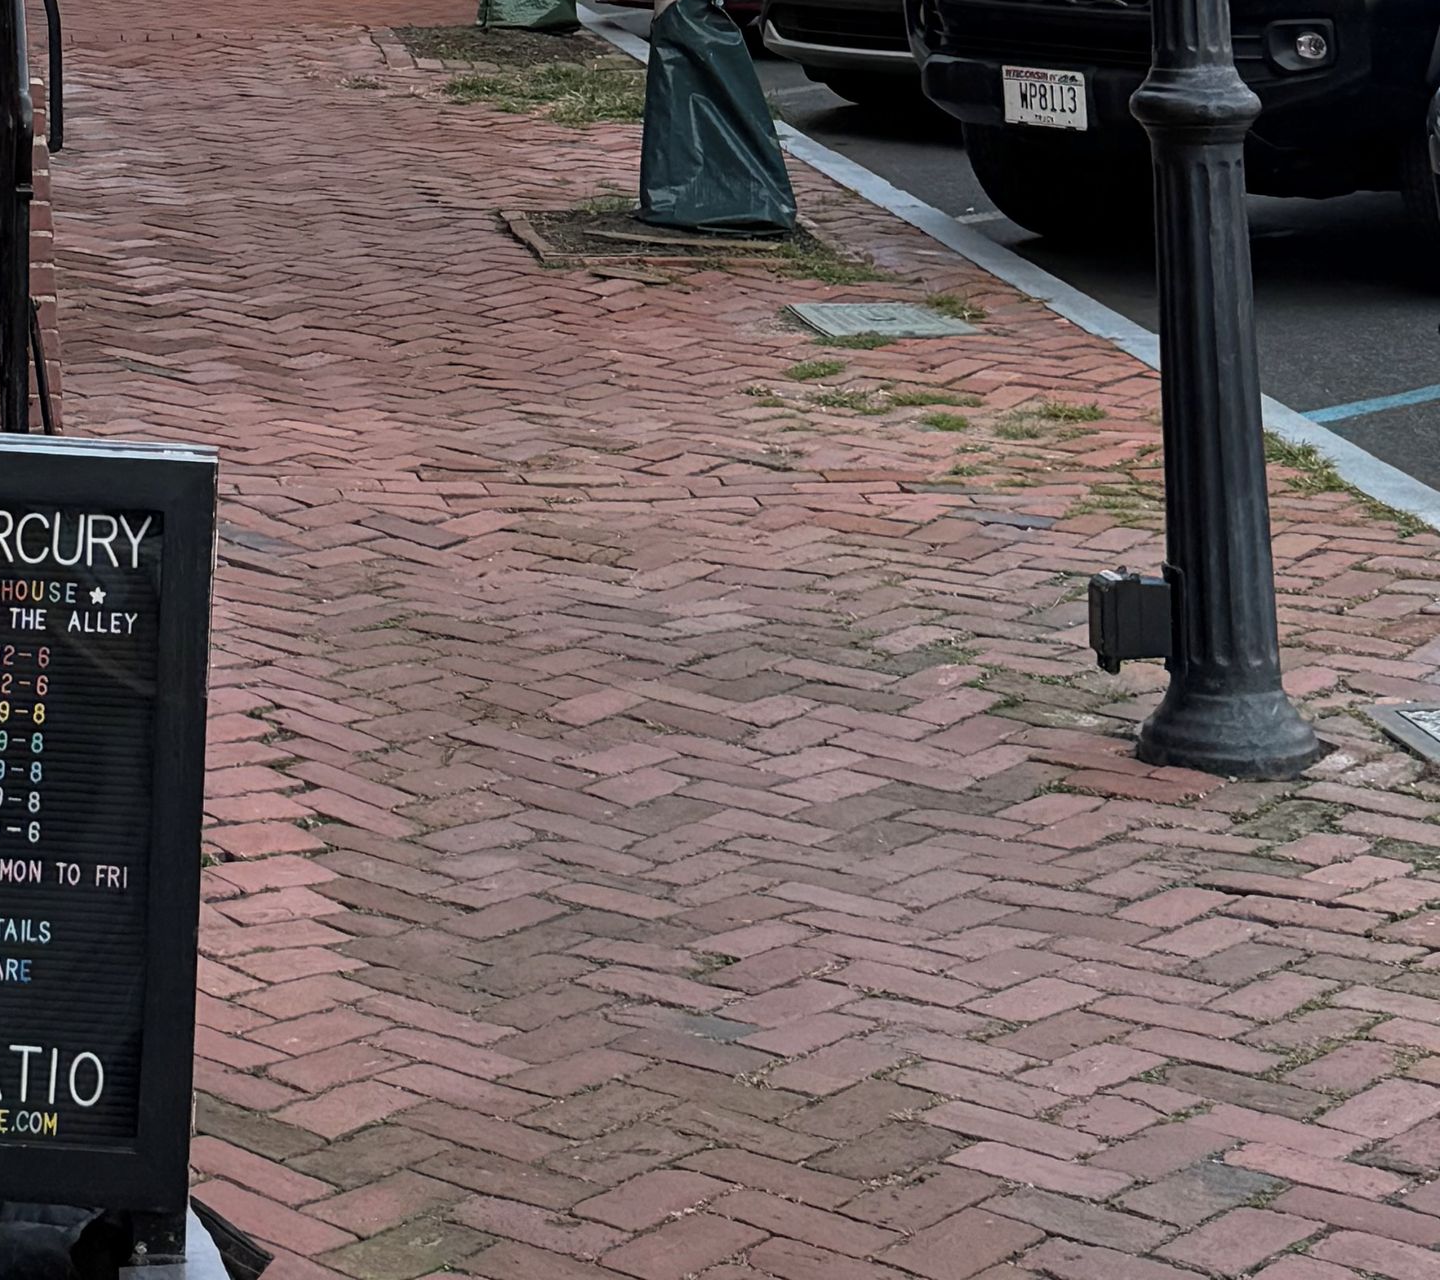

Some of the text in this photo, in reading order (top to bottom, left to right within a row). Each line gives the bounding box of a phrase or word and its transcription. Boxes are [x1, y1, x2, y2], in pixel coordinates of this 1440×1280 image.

[1019, 81, 1077, 114] WP8113
[0, 579, 78, 604] HOUSE
[10, 606, 47, 631] THE
[67, 611, 139, 635] ALLEY
[0, 858, 42, 883] MON
[56, 862, 81, 885] TO
[95, 865, 128, 889] FRI
